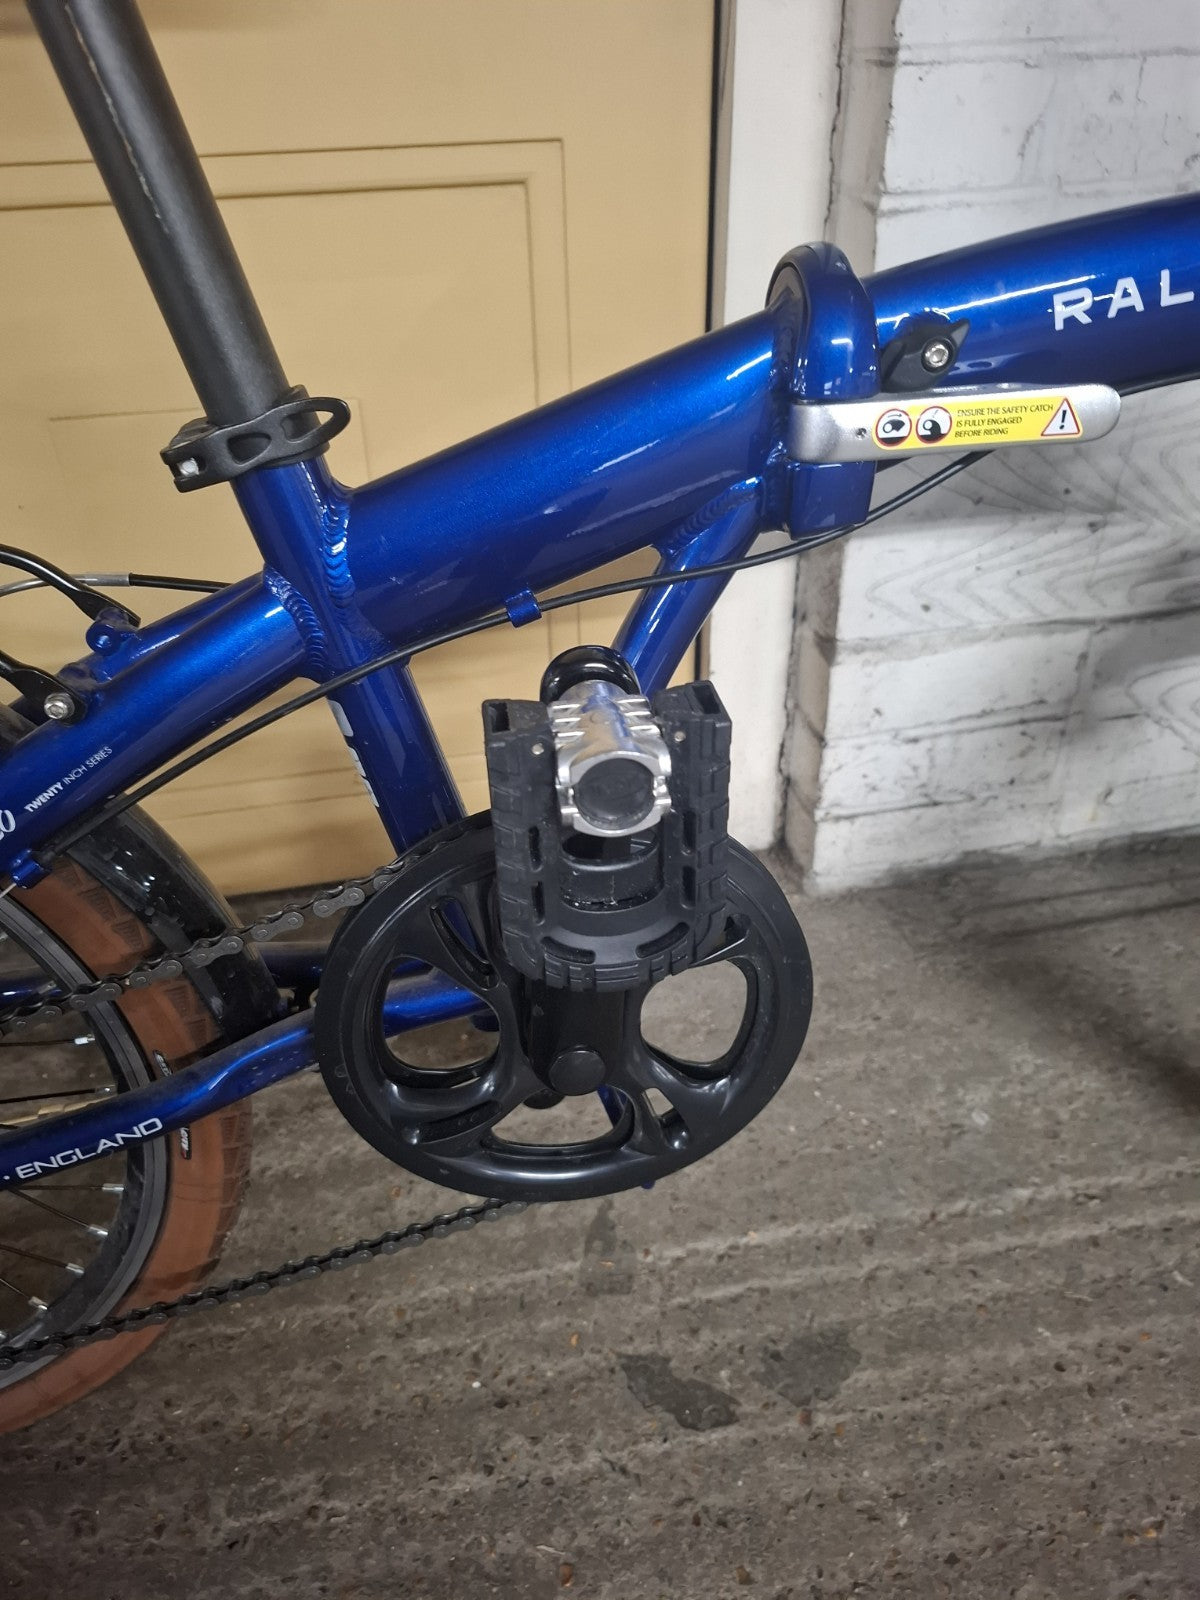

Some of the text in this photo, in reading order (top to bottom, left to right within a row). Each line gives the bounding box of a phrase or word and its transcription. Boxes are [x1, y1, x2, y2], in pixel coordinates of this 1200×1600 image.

[1053, 268, 1195, 331] RAL
[957, 404, 1054, 417] ENSURE THE SAFETY CATCH
[964, 418, 985, 427] FULLY
[987, 416, 1022, 425] ENGAGED
[955, 428, 1008, 438] BEFORE RIDING
[24, 746, 113, 812] TWENTY INCH SERIES
[15, 1117, 163, 1179] ENGLAND
